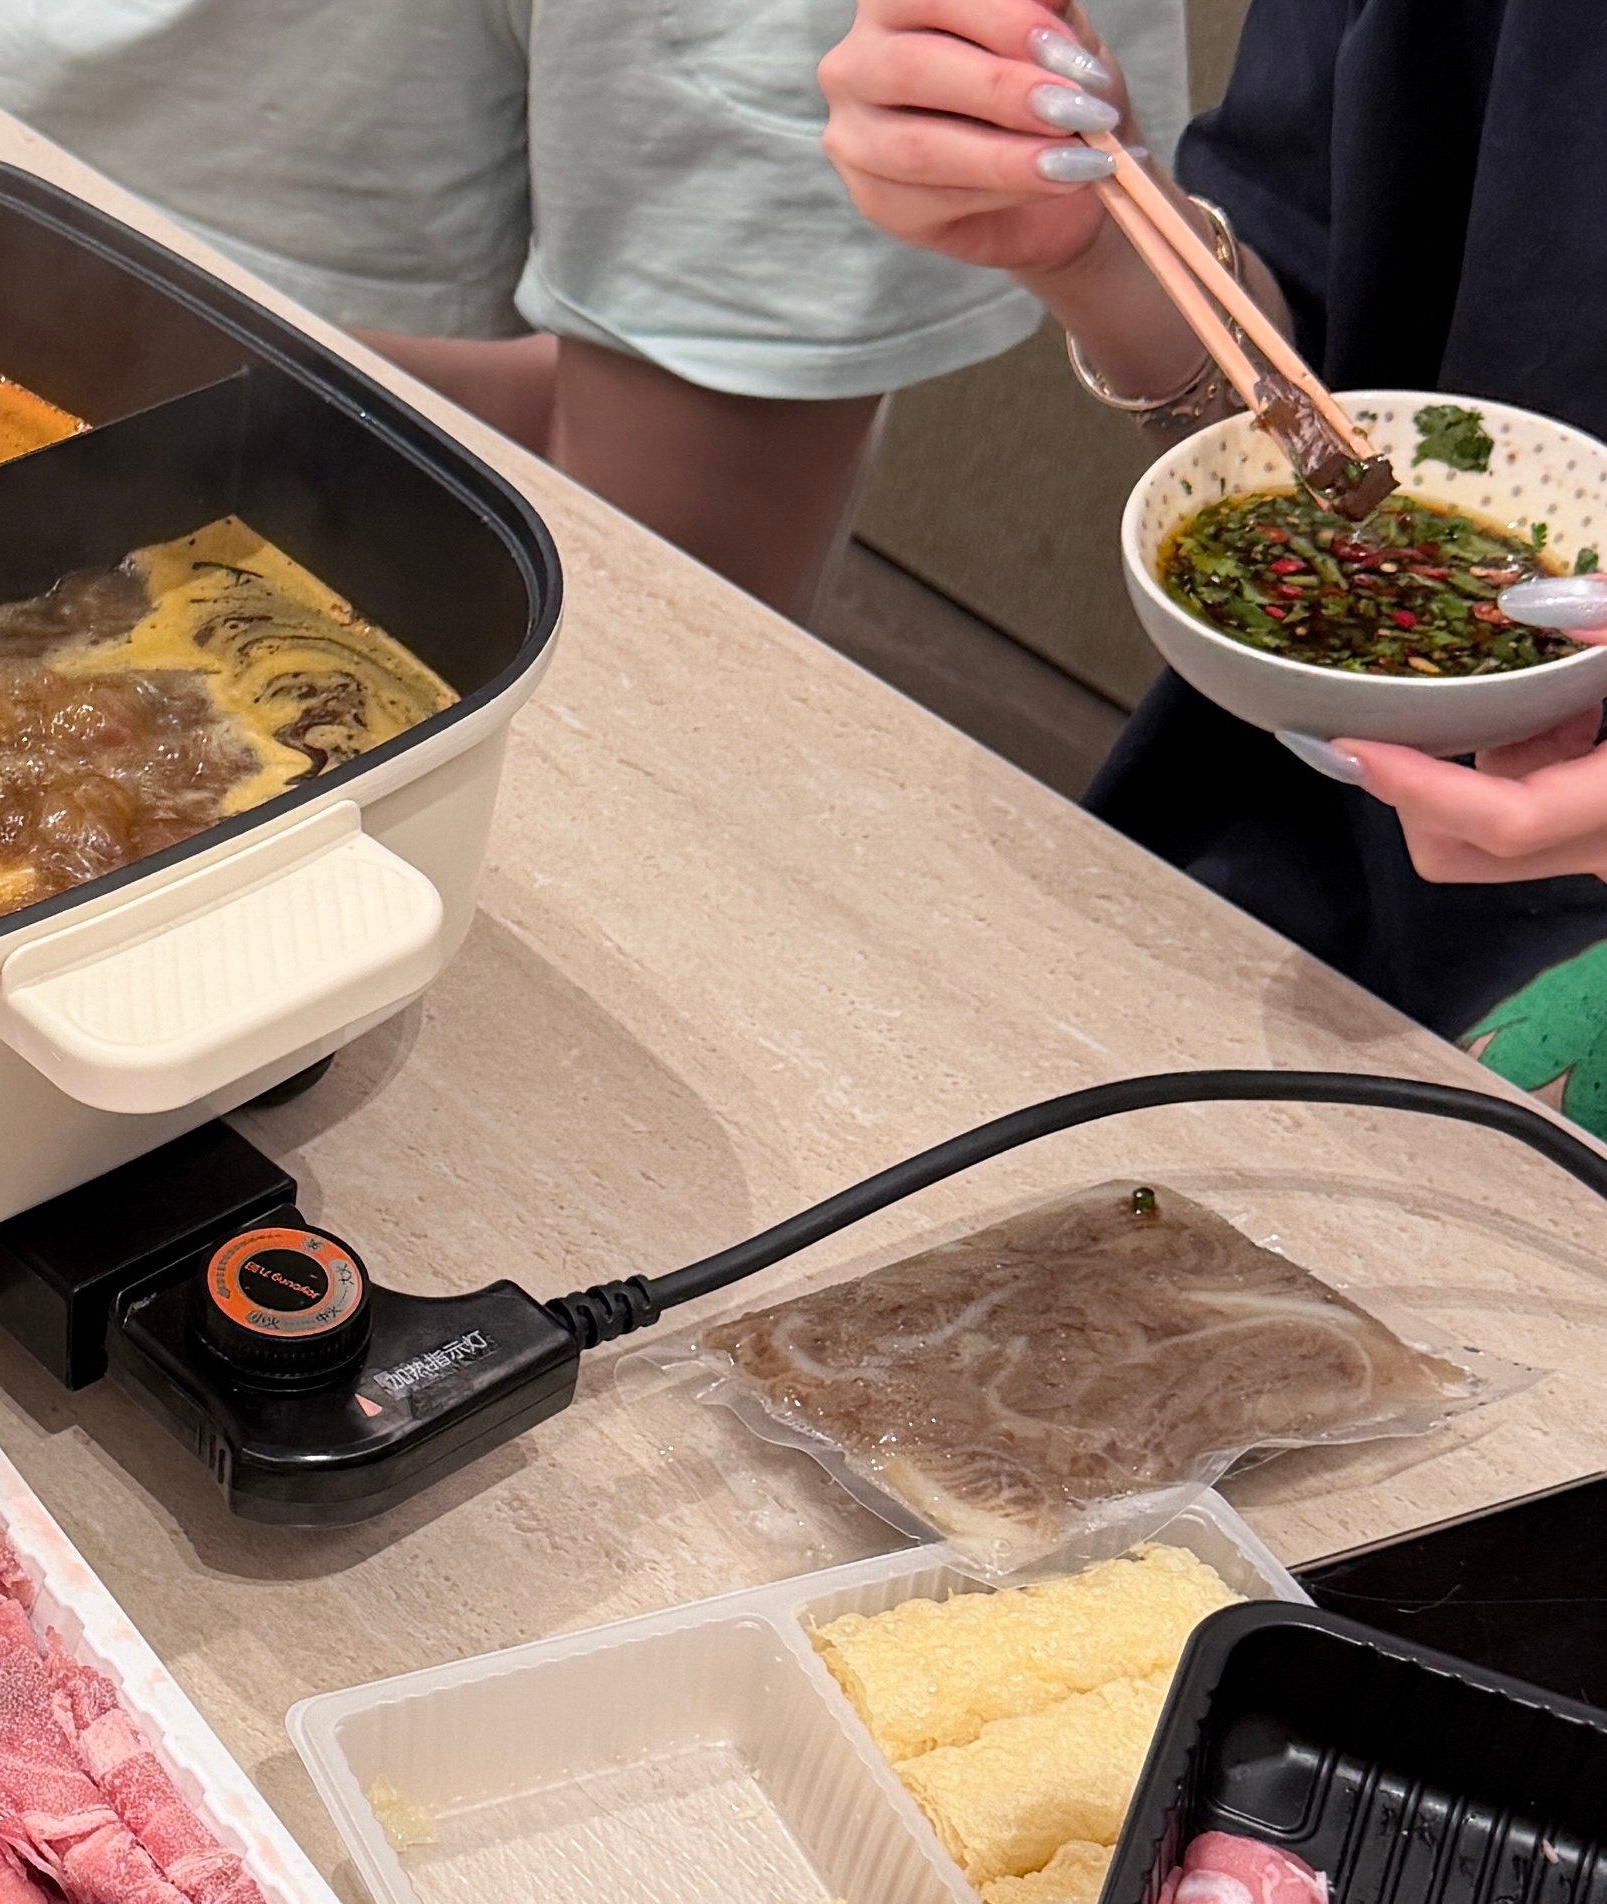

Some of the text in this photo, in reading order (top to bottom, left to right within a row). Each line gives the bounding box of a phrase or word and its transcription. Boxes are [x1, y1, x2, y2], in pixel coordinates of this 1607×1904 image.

[271, 1272, 321, 1300] Joyoung
[385, 1329, 487, 1390] 加热指示灯
